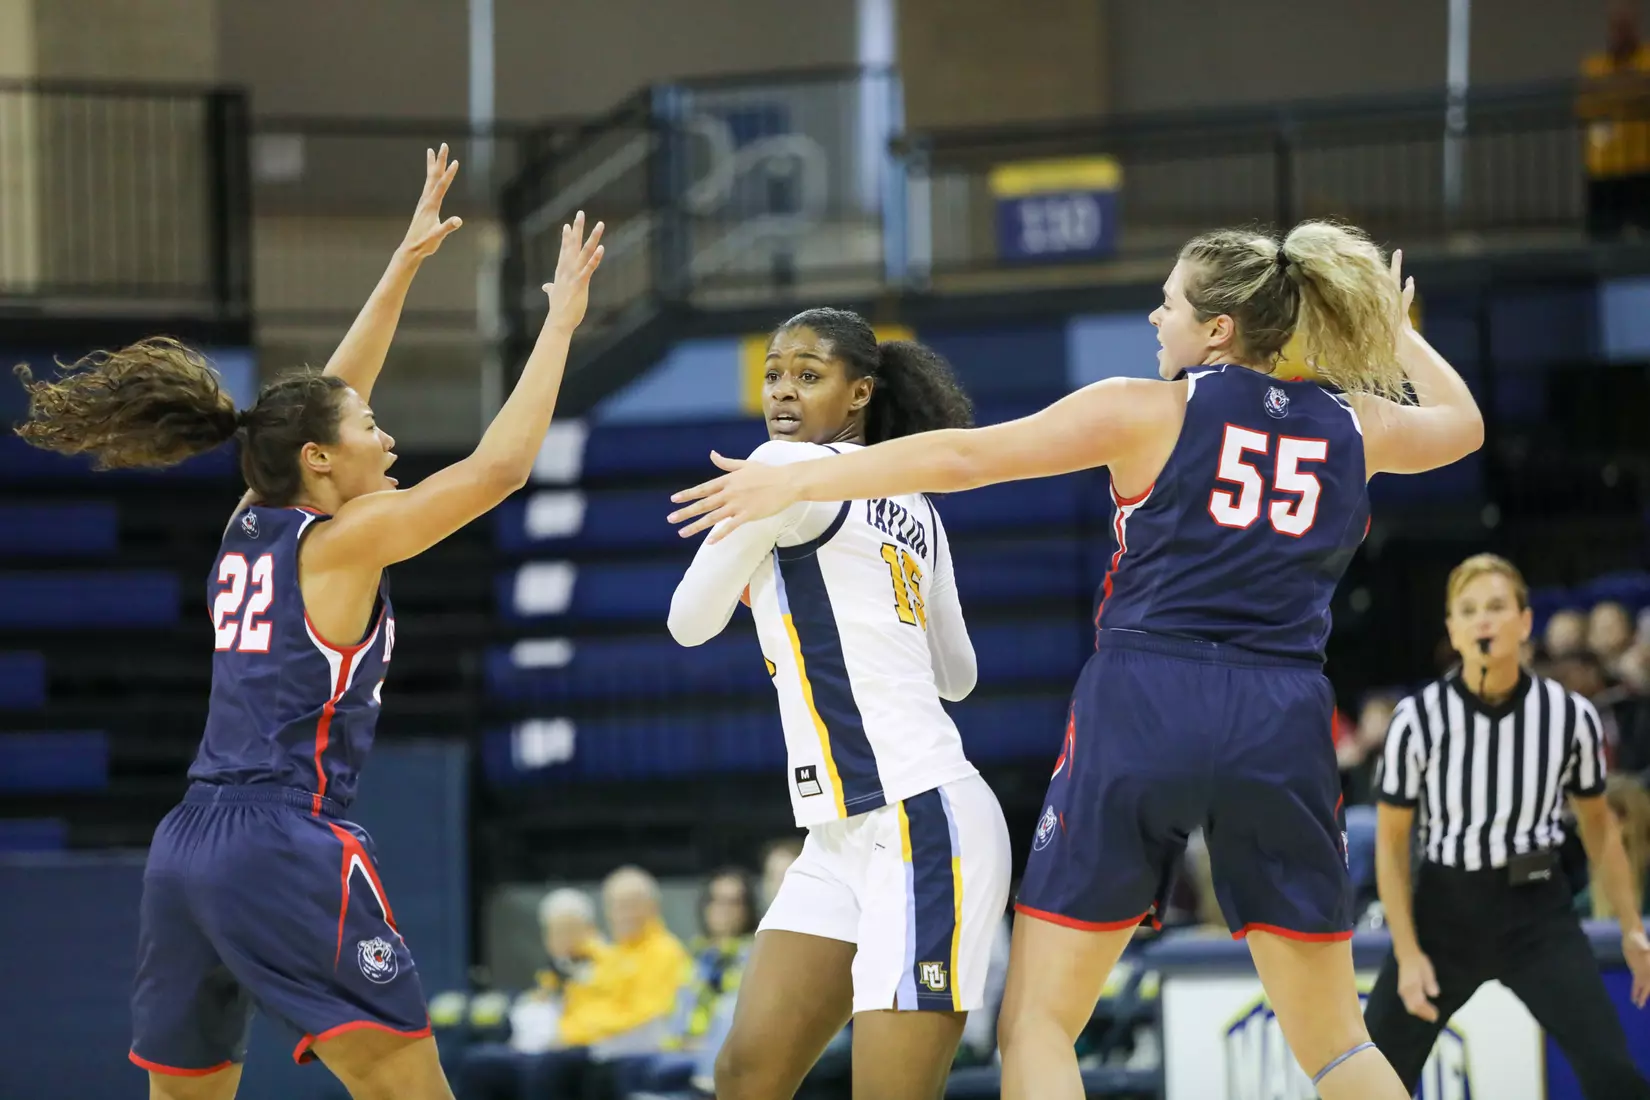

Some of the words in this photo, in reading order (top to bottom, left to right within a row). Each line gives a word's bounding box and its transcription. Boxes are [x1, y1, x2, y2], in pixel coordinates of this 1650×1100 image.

[1207, 422, 1330, 539] 55
[213, 552, 274, 654] 22
[880, 541, 928, 632] 15
[800, 768, 810, 780] M
[918, 961, 947, 991] MU
